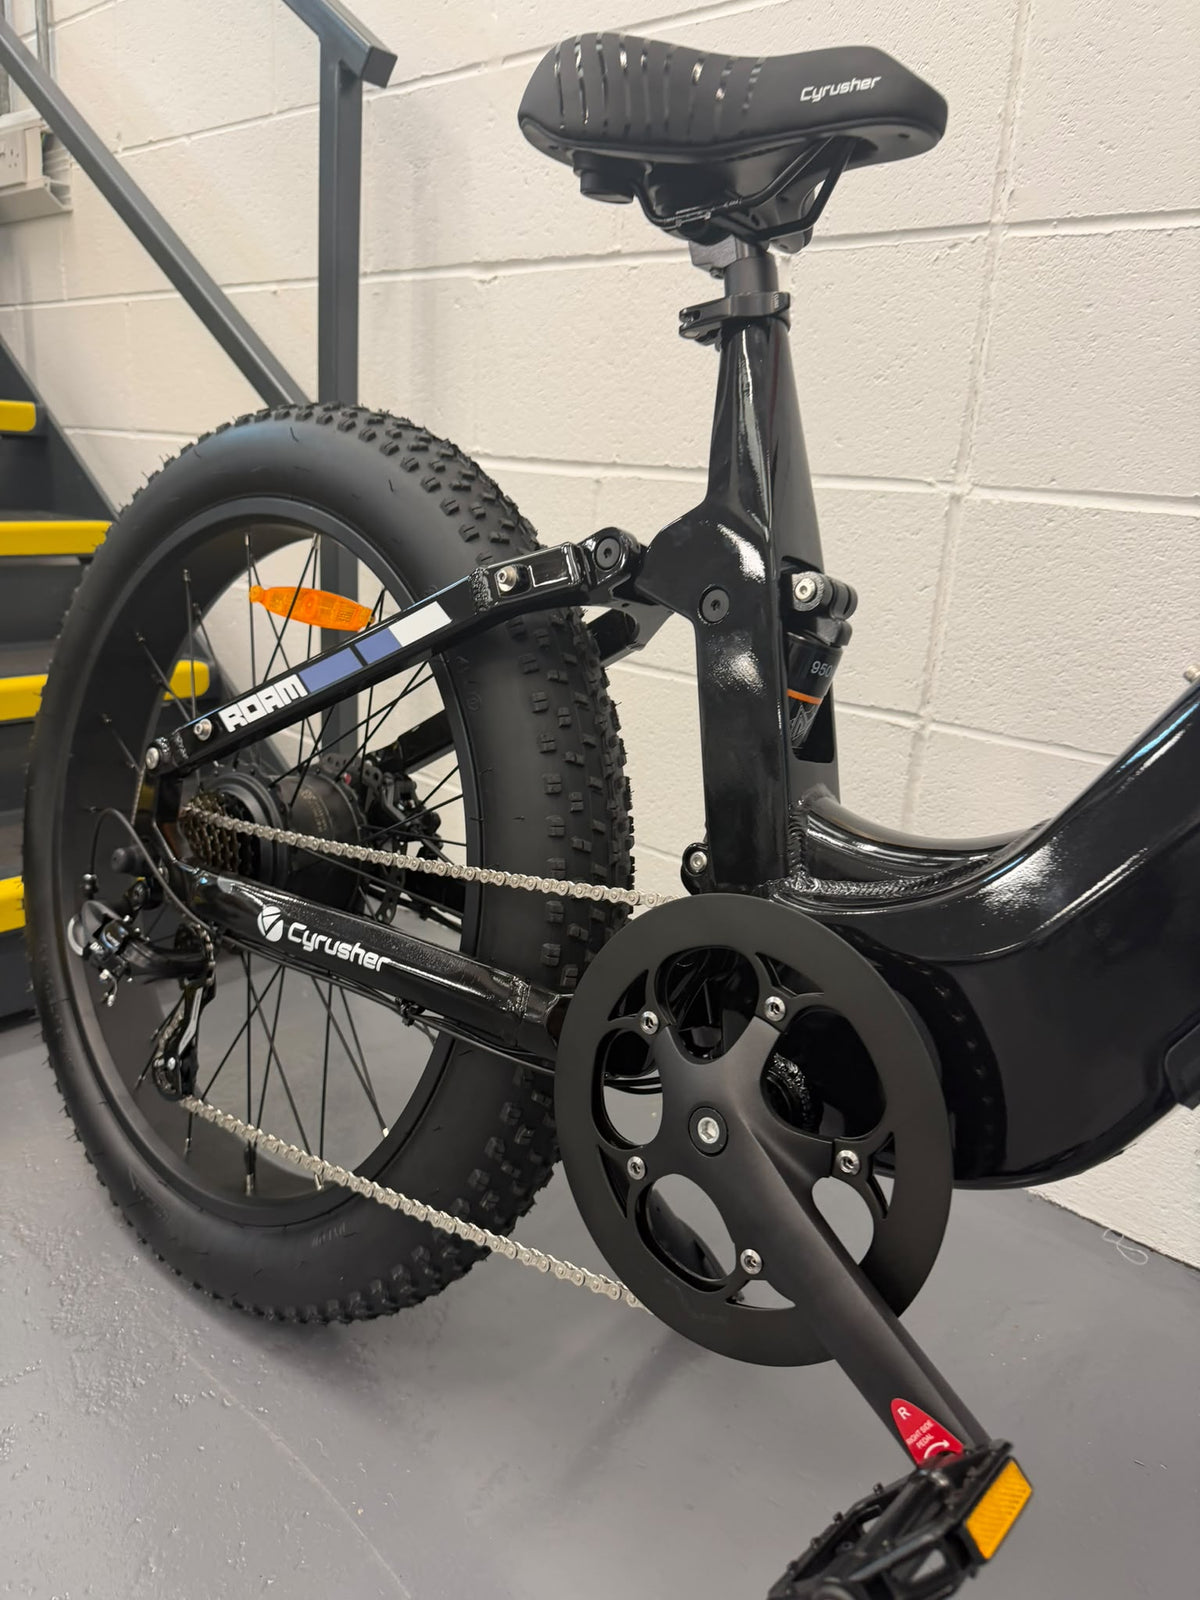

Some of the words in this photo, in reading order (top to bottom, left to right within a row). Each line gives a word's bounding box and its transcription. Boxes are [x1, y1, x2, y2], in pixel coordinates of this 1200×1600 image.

[800, 76, 882, 102] Cyrusher
[811, 660, 833, 678] 950
[218, 673, 308, 733] ROAM
[287, 921, 391, 972] Cyrusher
[897, 1406, 912, 1420] R
[905, 1429, 922, 1446] RIGHT
[919, 1420, 934, 1434] SIDE
[915, 1433, 934, 1449] PEDAL
